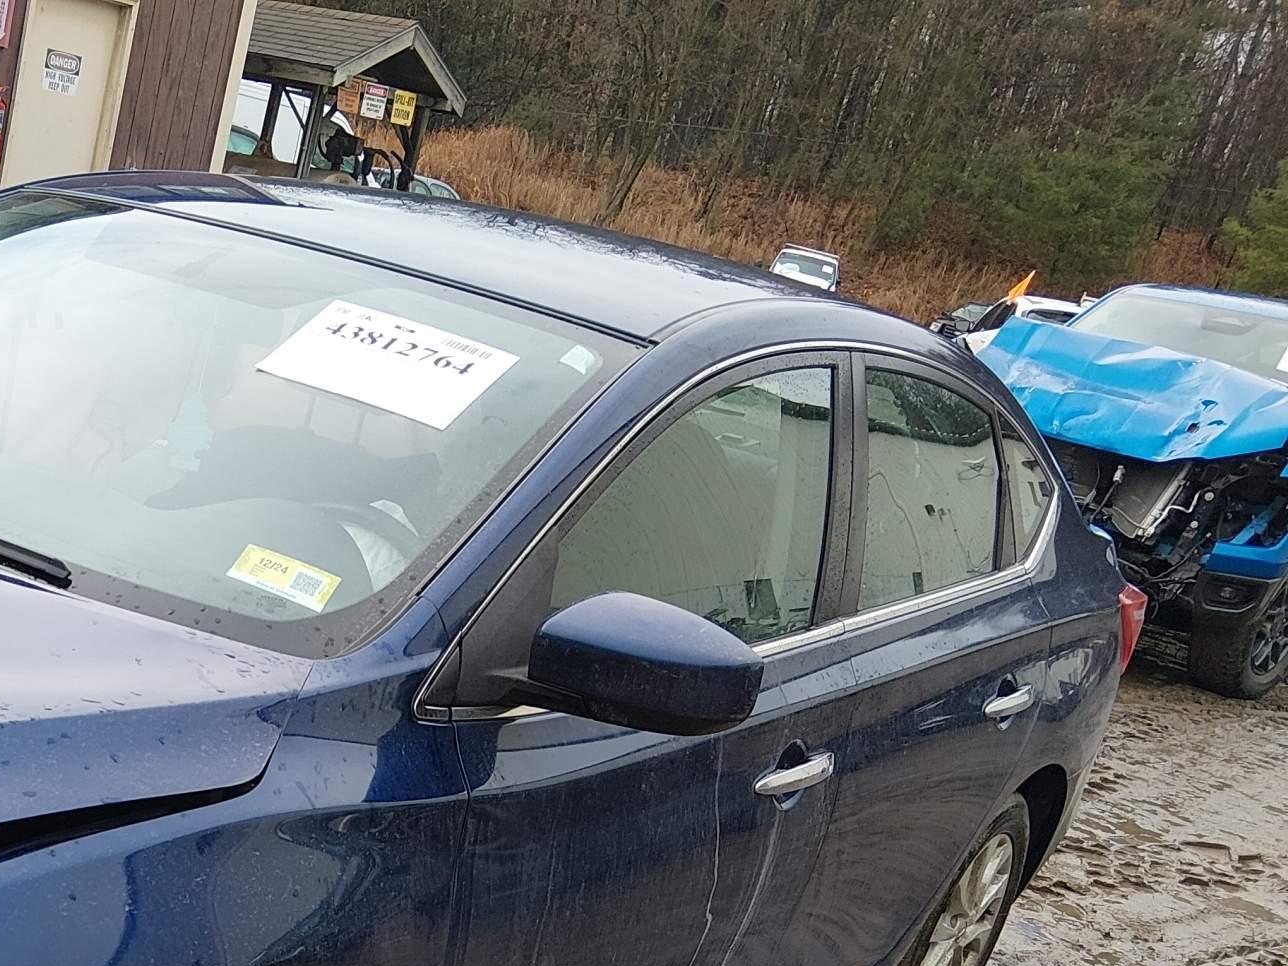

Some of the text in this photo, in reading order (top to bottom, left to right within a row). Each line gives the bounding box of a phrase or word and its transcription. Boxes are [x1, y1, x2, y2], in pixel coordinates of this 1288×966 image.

[50, 55, 77, 70] DANGER
[48, 81, 70, 94] KEEP OUT
[394, 108, 410, 120] STATION
[325, 322, 475, 375] 43812764
[258, 557, 289, 575] 12/24
